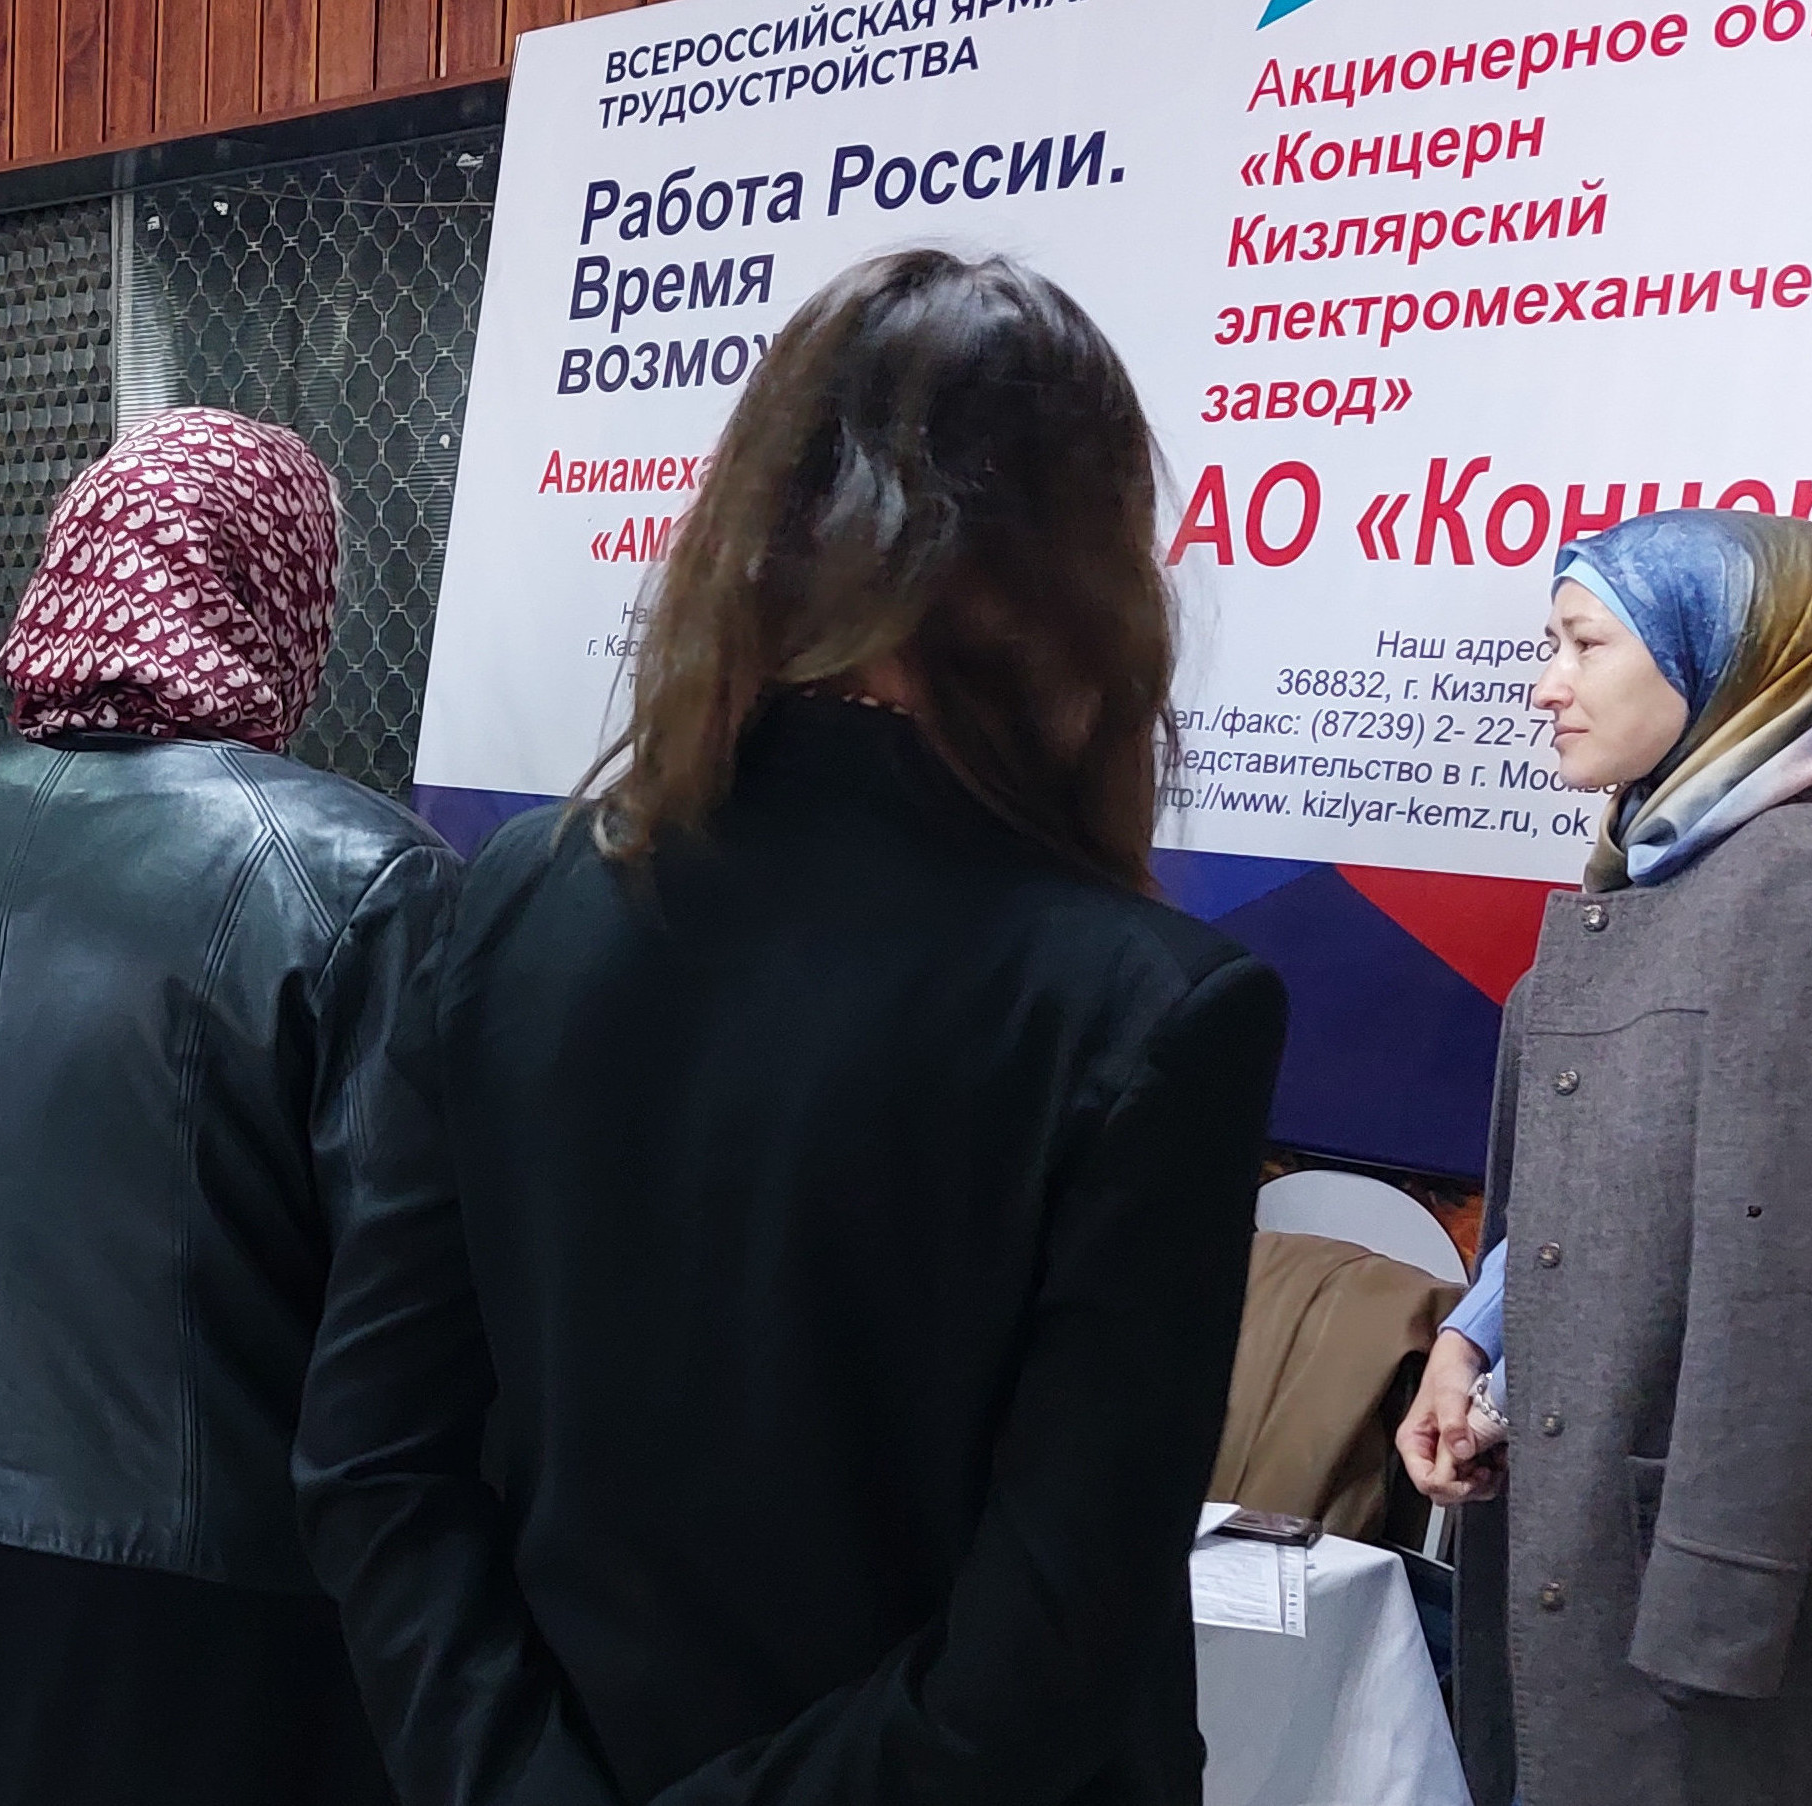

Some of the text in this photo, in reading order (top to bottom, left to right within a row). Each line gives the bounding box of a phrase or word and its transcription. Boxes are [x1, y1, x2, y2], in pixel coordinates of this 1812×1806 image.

[605, 0, 937, 84] ВСЕРОССИЙСКАЯ
[1247, 0, 1812, 112] Акционерное об
[599, 36, 979, 129] ТРУДОУСТРОЙСТВА
[1239, 116, 1546, 187] «Концерн
[579, 130, 1126, 245] Работа России.
[1226, 178, 1609, 268] Кизлярский
[569, 254, 775, 333] Время
[1214, 263, 1812, 349] электромеханиче
[1201, 374, 1414, 427] завод»
[538, 449, 715, 494] Авиамеха
[590, 516, 674, 562] «АМ
[1165, 460, 1321, 568] АО
[621, 602, 648, 624] На
[587, 634, 644, 656] г. Кас
[1376, 630, 1446, 659] Наш
[1276, 668, 1391, 703] 368832,
[1403, 679, 1419, 699] г.
[1173, 704, 1302, 739] ел./факс:
[1311, 708, 1426, 749] (87239)
[1433, 714, 1466, 743] 2-
[1166, 749, 1433, 784] едставительство
[1442, 763, 1461, 785] в
[1470, 765, 1486, 787] г.
[1302, 789, 1538, 838] kizlyar-kemz.ru,
